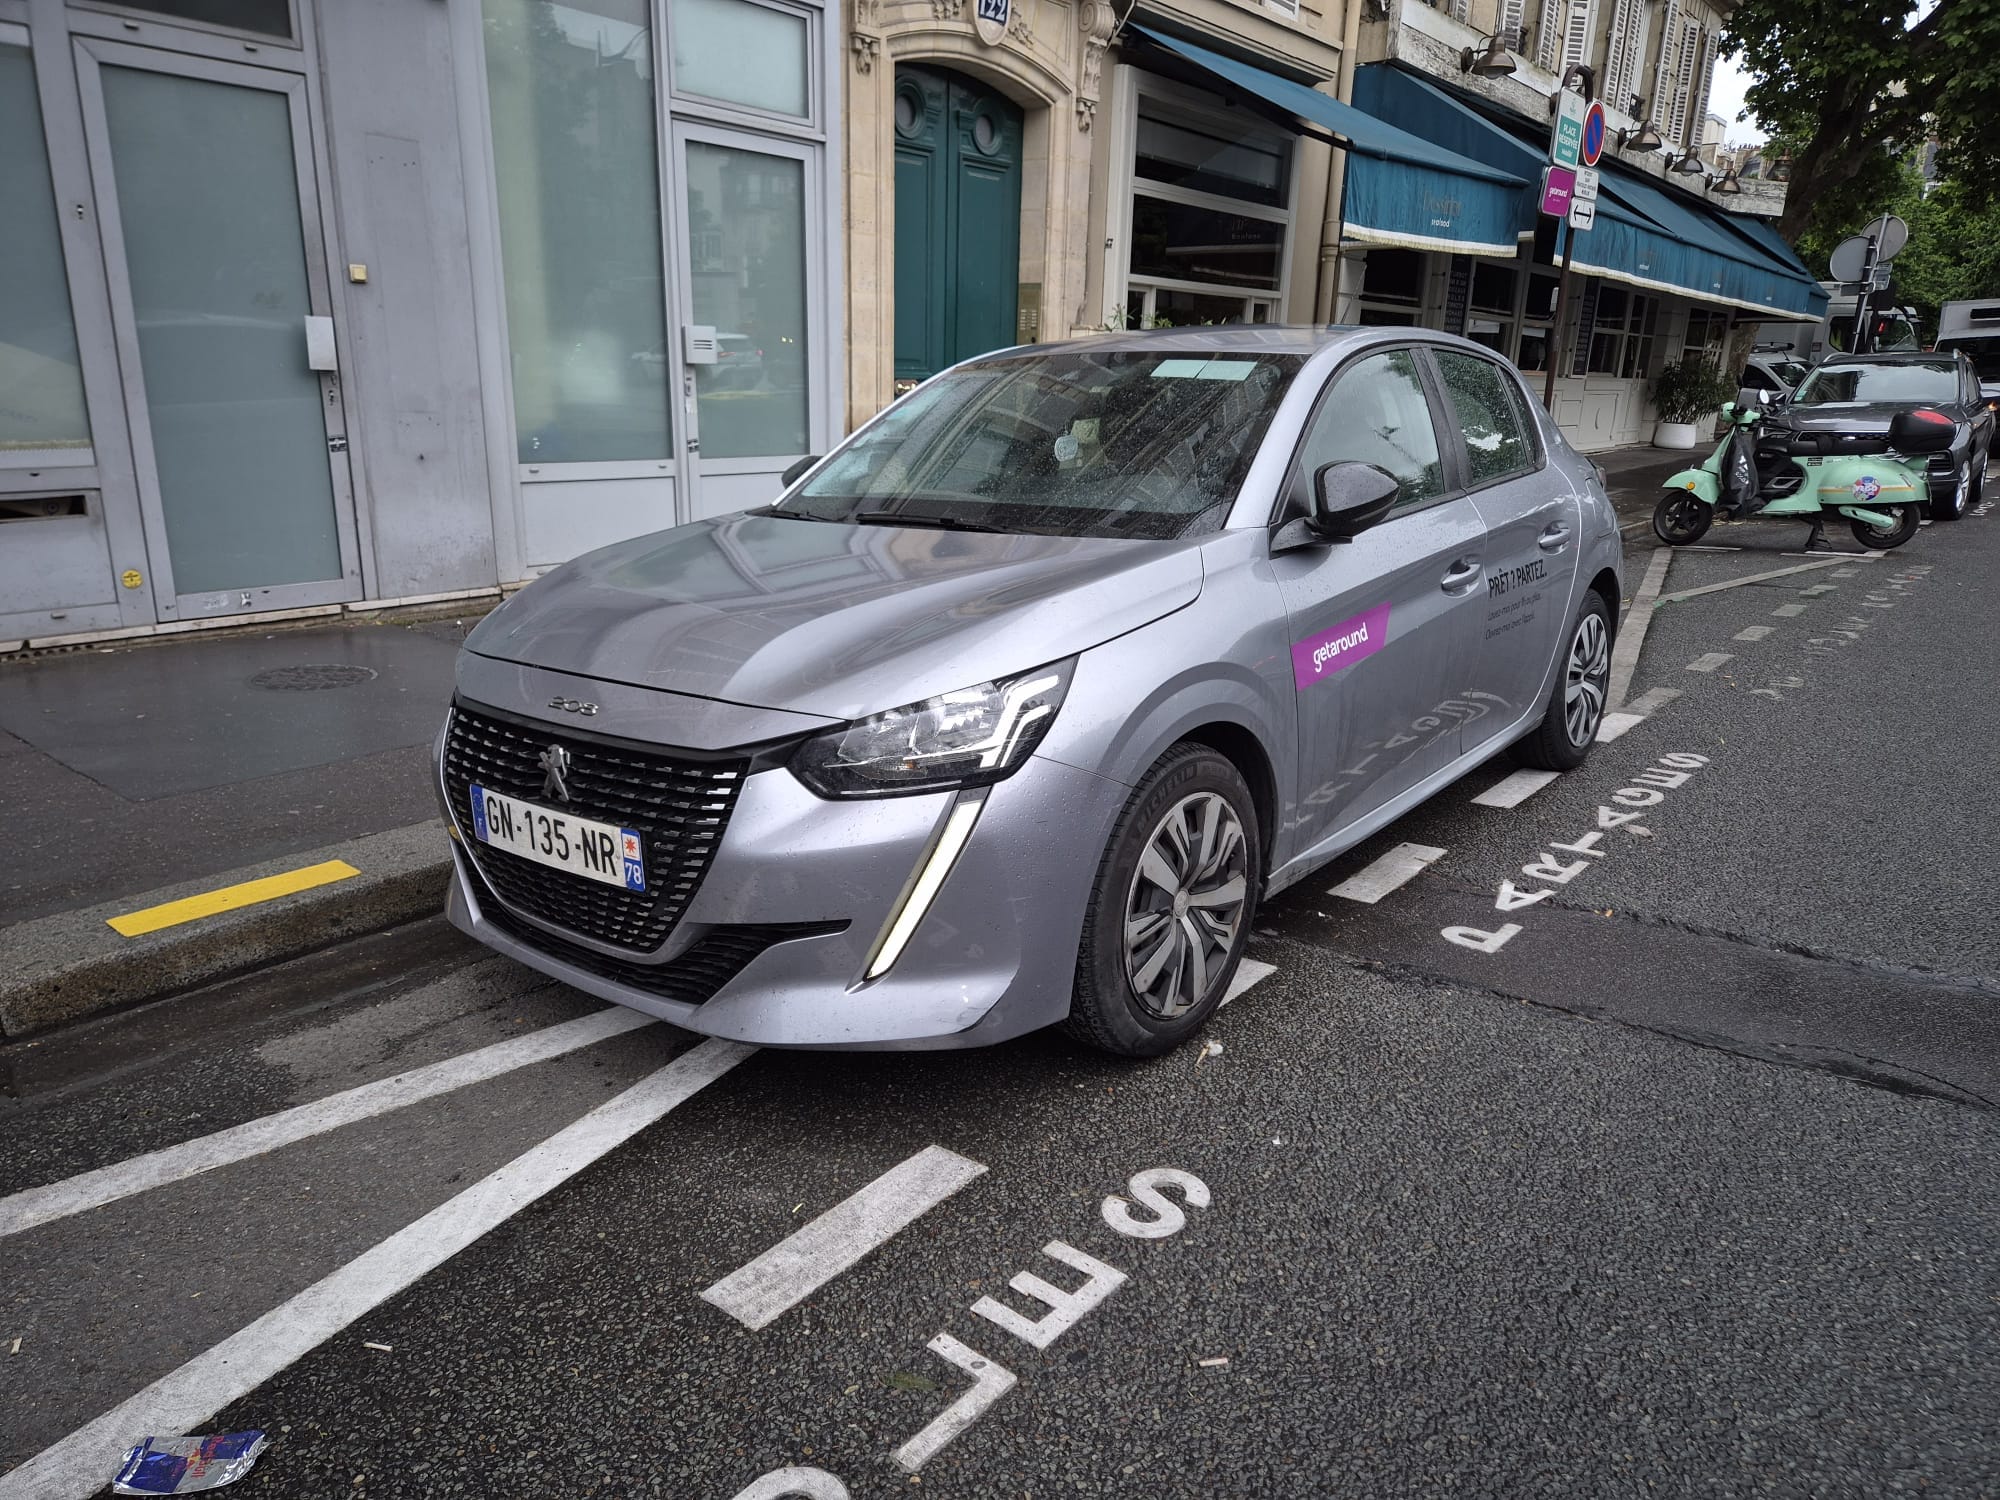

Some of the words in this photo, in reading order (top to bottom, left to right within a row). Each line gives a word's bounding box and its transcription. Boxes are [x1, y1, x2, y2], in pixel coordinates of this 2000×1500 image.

[979, 0, 1007, 20] 122
[1563, 124, 1576, 137] PLACE
[1488, 568, 1509, 599] PRÊT
[1516, 559, 1547, 587] PARTEZ.
[1312, 622, 1369, 673] getaround
[548, 696, 599, 716] 208
[477, 817, 483, 829] F
[486, 795, 618, 877] GN-135-NR
[624, 862, 643, 885] 78
